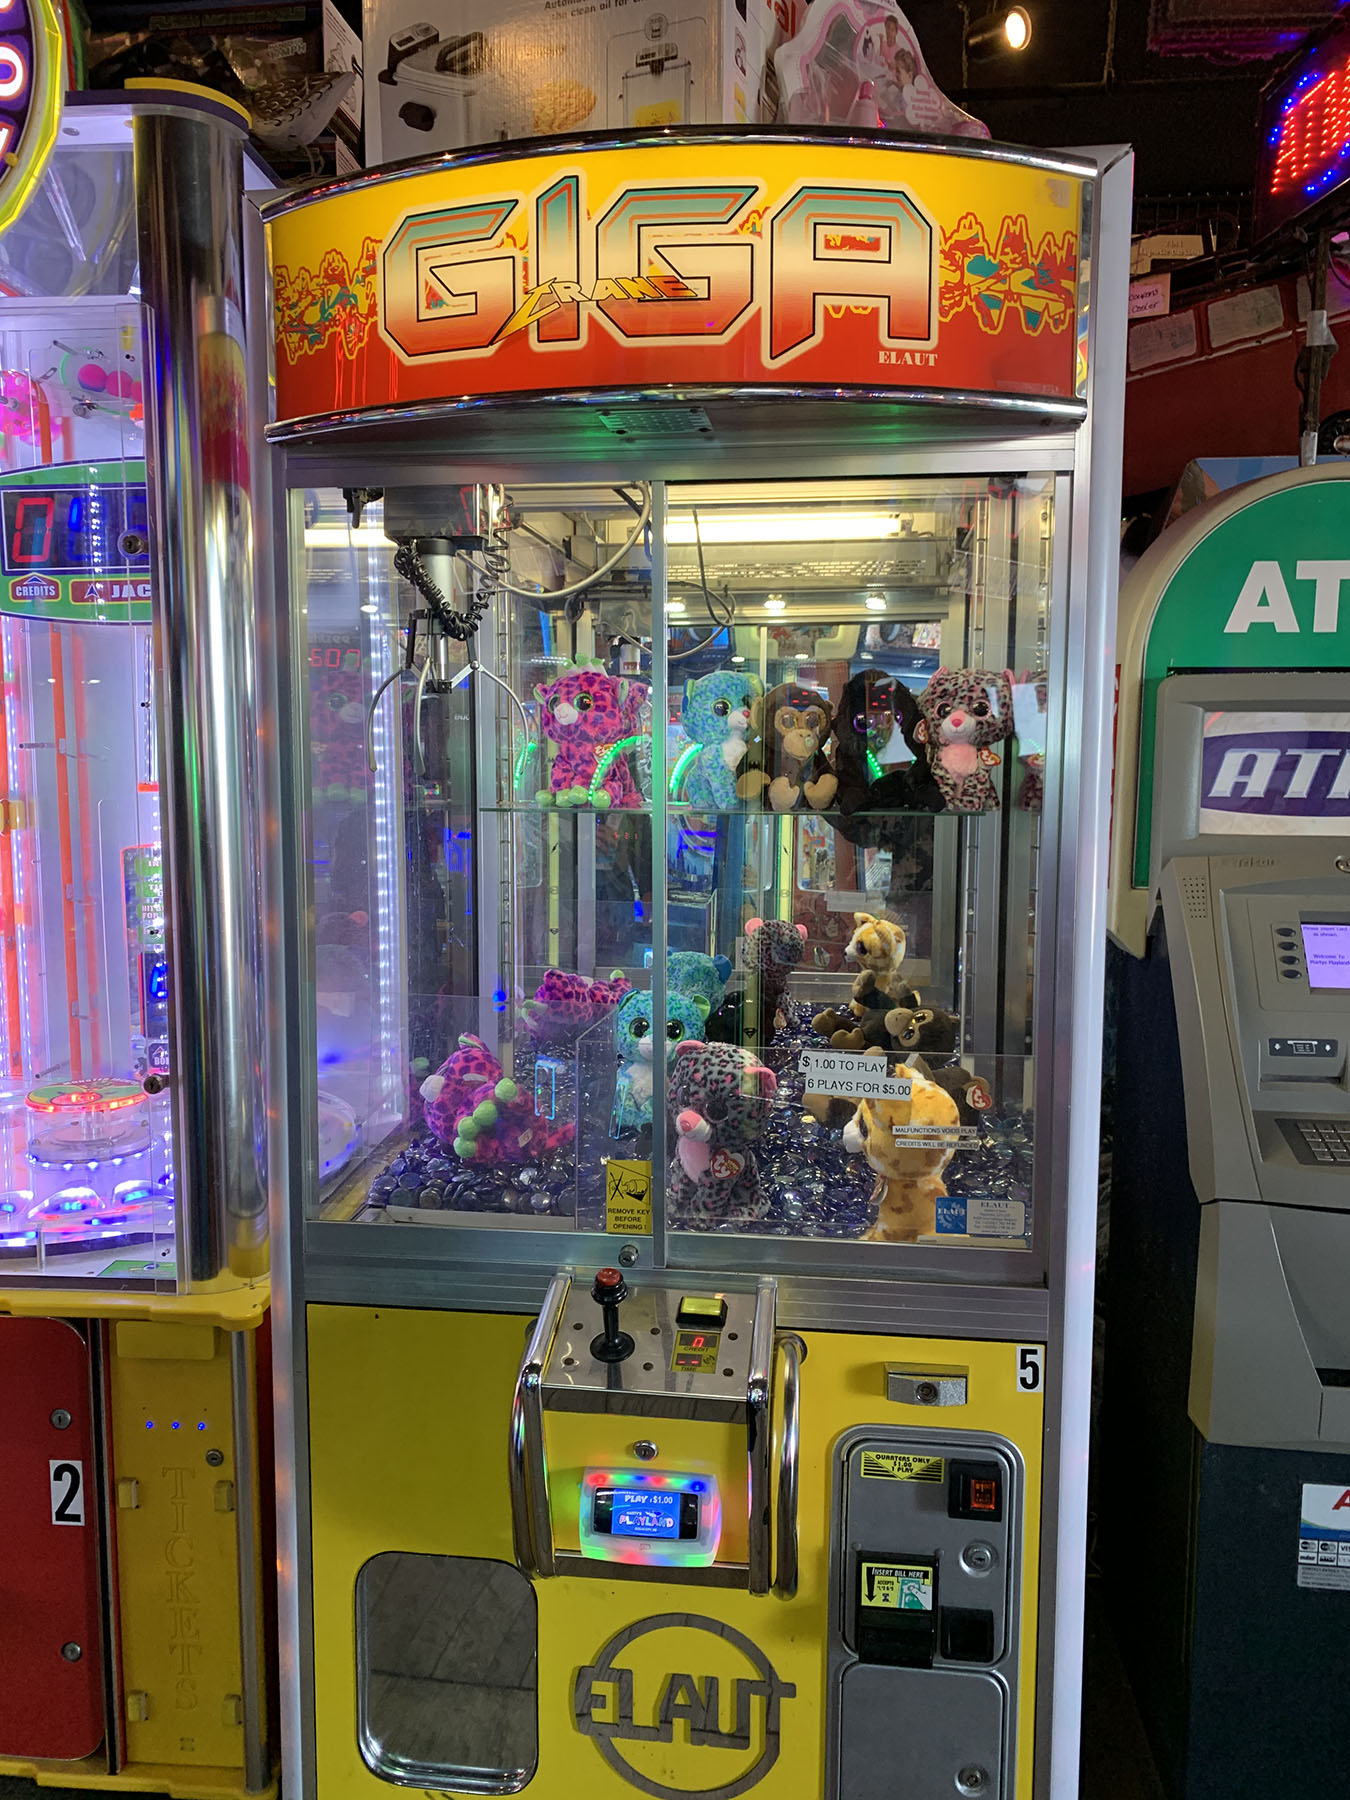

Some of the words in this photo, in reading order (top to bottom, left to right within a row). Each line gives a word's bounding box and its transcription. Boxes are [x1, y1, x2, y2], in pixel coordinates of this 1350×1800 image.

[382, 174, 934, 361] GIGA
[878, 351, 938, 367] ELAUT
[15, 585, 56, 597] CREDITS
[838, 1060, 855, 1071] TO
[857, 1061, 886, 1073] PLAY
[807, 1079, 815, 1089] 6
[817, 1079, 853, 1092] PLAYS
[855, 1082, 880, 1093] FOR
[882, 1083, 911, 1096] $5.00
[922, 1140, 936, 1148] WILL
[607, 1207, 636, 1215] REMOVE
[1020, 1348, 1040, 1390] 5
[912, 1456, 931, 1464] ONLY
[897, 1466, 914, 1474] PLAY
[52, 1463, 82, 1523] 2
[624, 1494, 649, 1504] PLAY
[618, 1514, 675, 1528] PLAYLAND
[871, 1567, 894, 1577] INSERT
[161, 1465, 204, 1713] TICKETS
[574, 1666, 797, 1750] ELAUT
